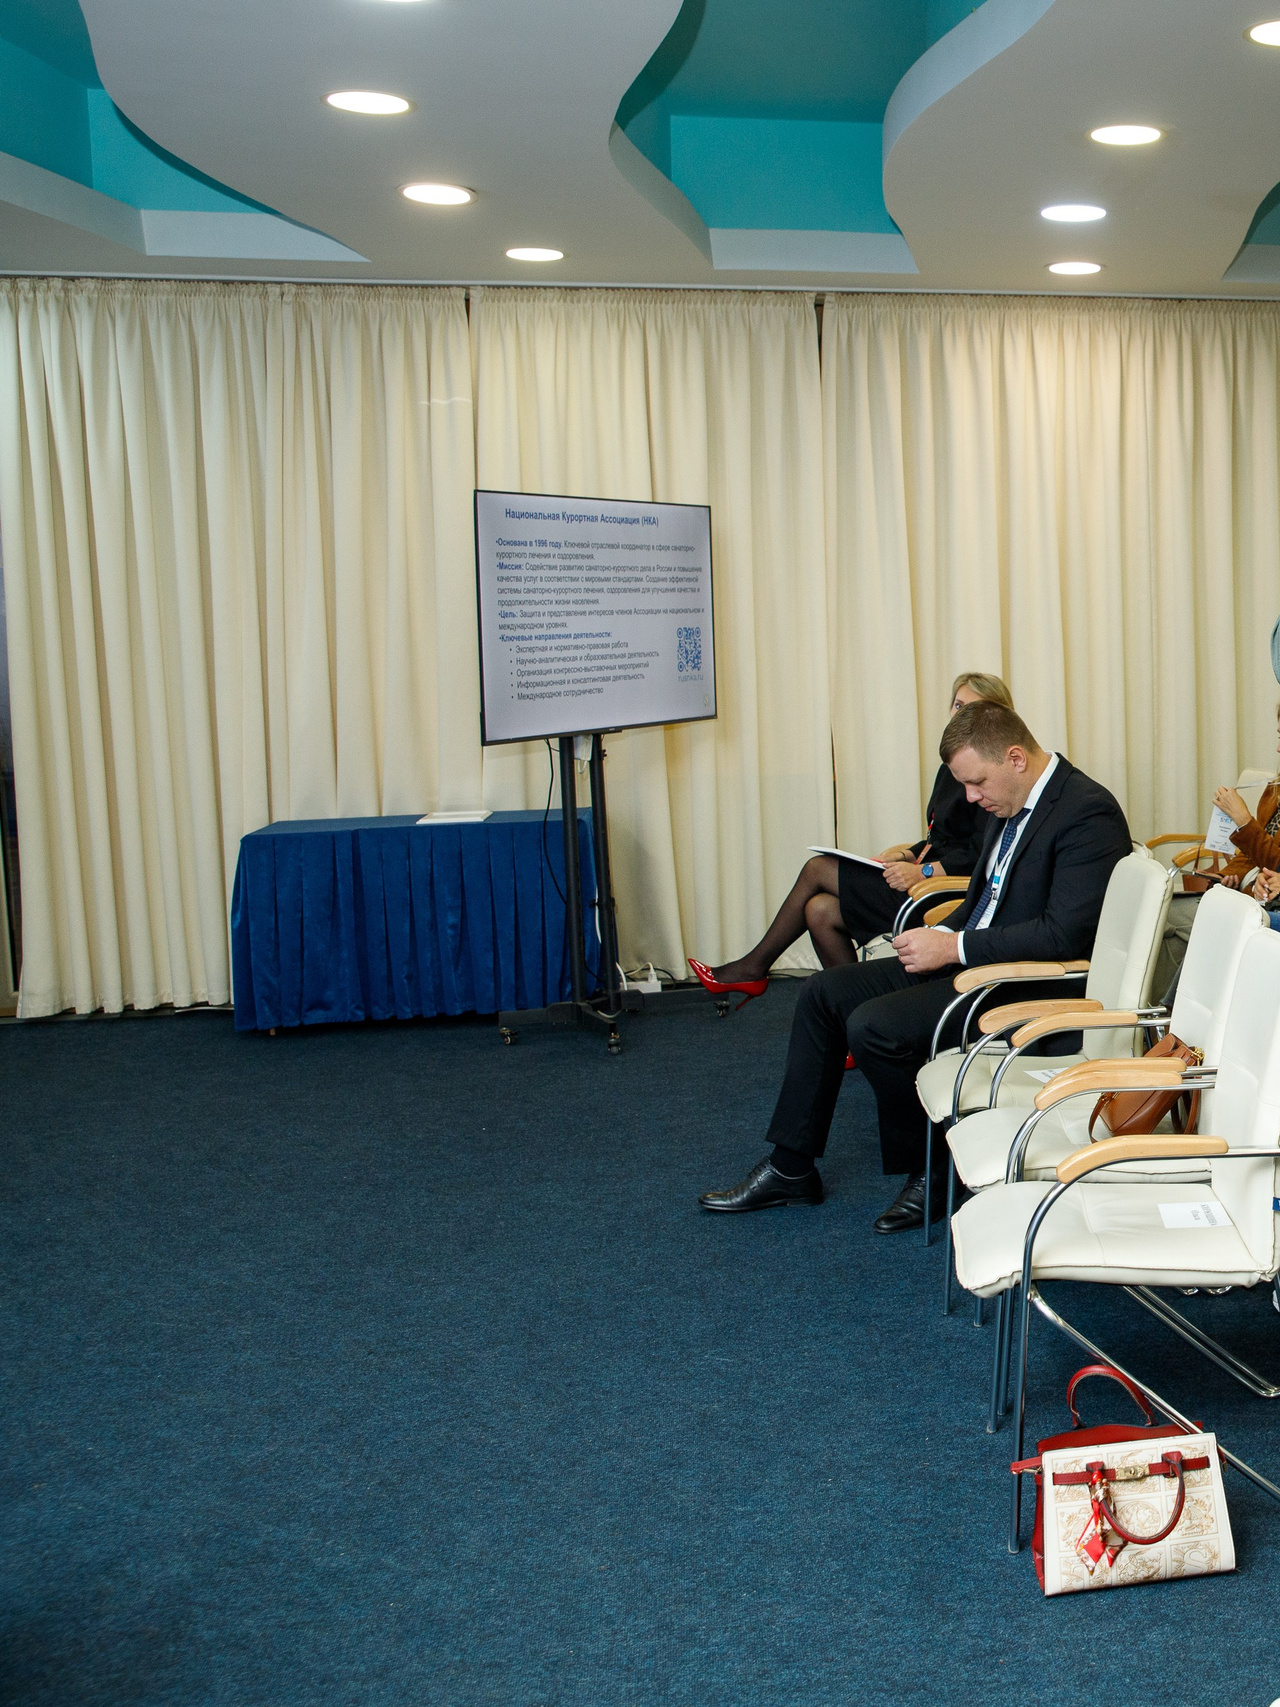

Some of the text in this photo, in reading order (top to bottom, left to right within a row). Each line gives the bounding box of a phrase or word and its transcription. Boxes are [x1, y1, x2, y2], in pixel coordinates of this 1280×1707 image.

[505, 508, 659, 527] Национальная Курортная Ассоциация (НКА)
[501, 633, 533, 642] Ключевые
[534, 633, 572, 642] направления
